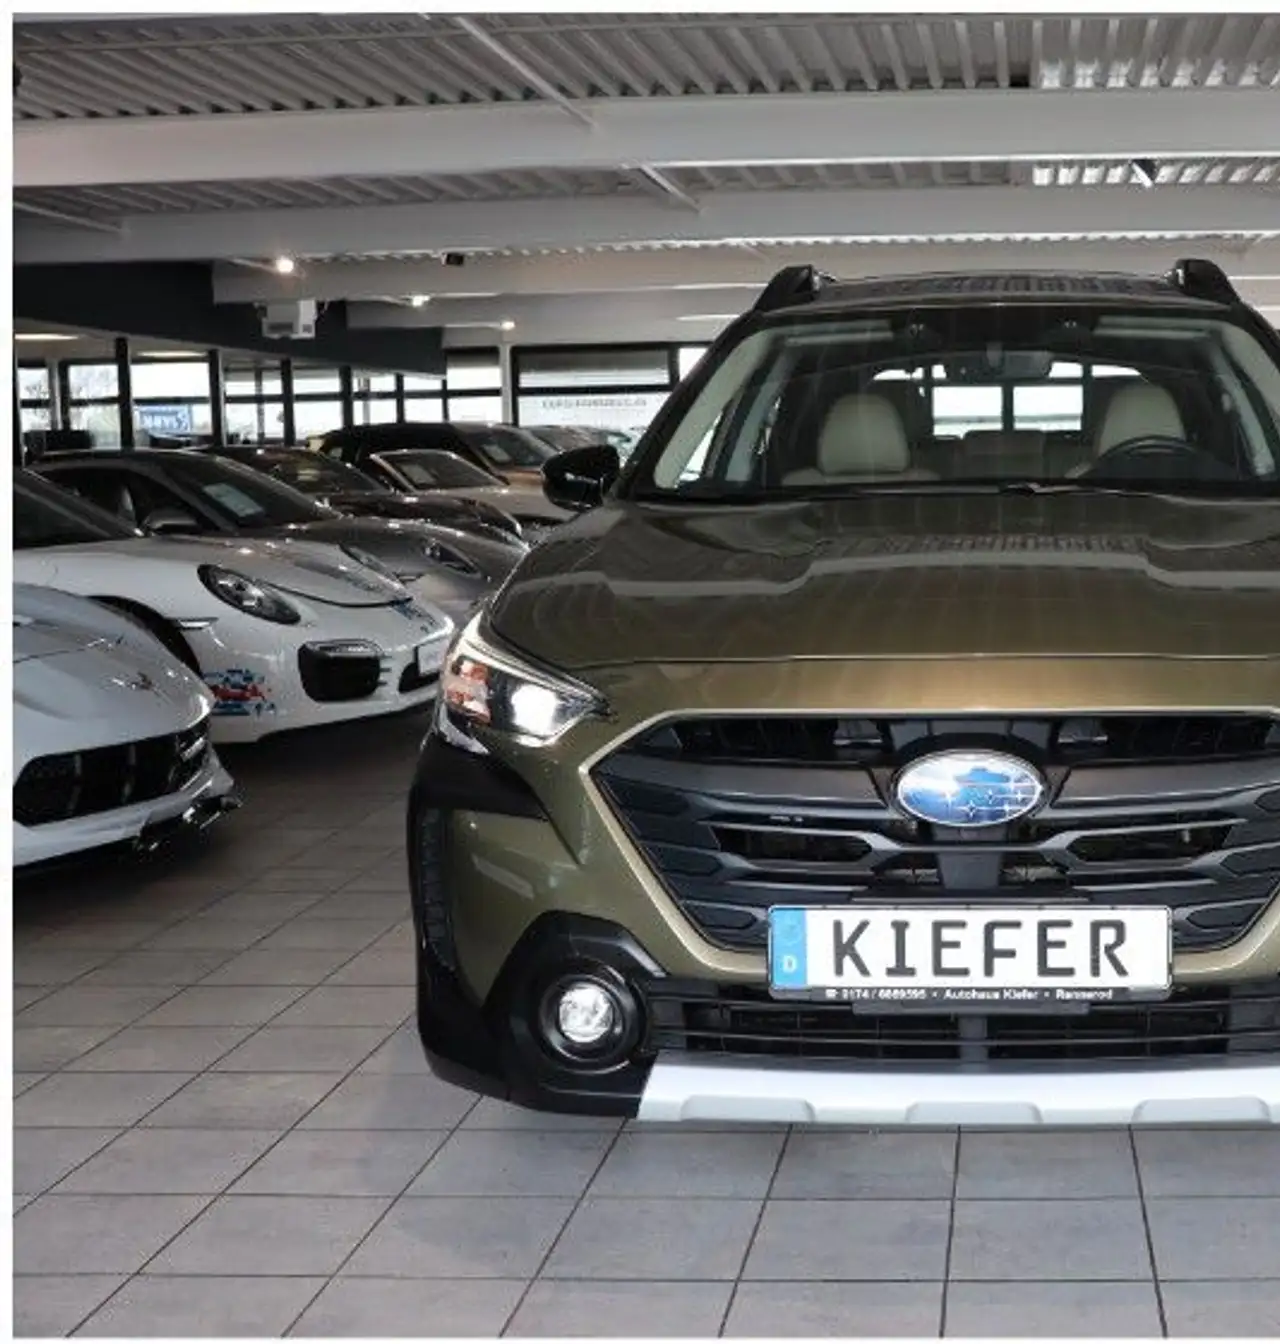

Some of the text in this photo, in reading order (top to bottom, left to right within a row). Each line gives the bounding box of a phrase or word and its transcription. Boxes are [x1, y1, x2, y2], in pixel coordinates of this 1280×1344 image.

[832, 919, 1129, 978] KIEFER
[783, 955, 797, 973] D
[943, 988, 999, 1000] Autohaus
[1003, 988, 1038, 1000] Kiefer
